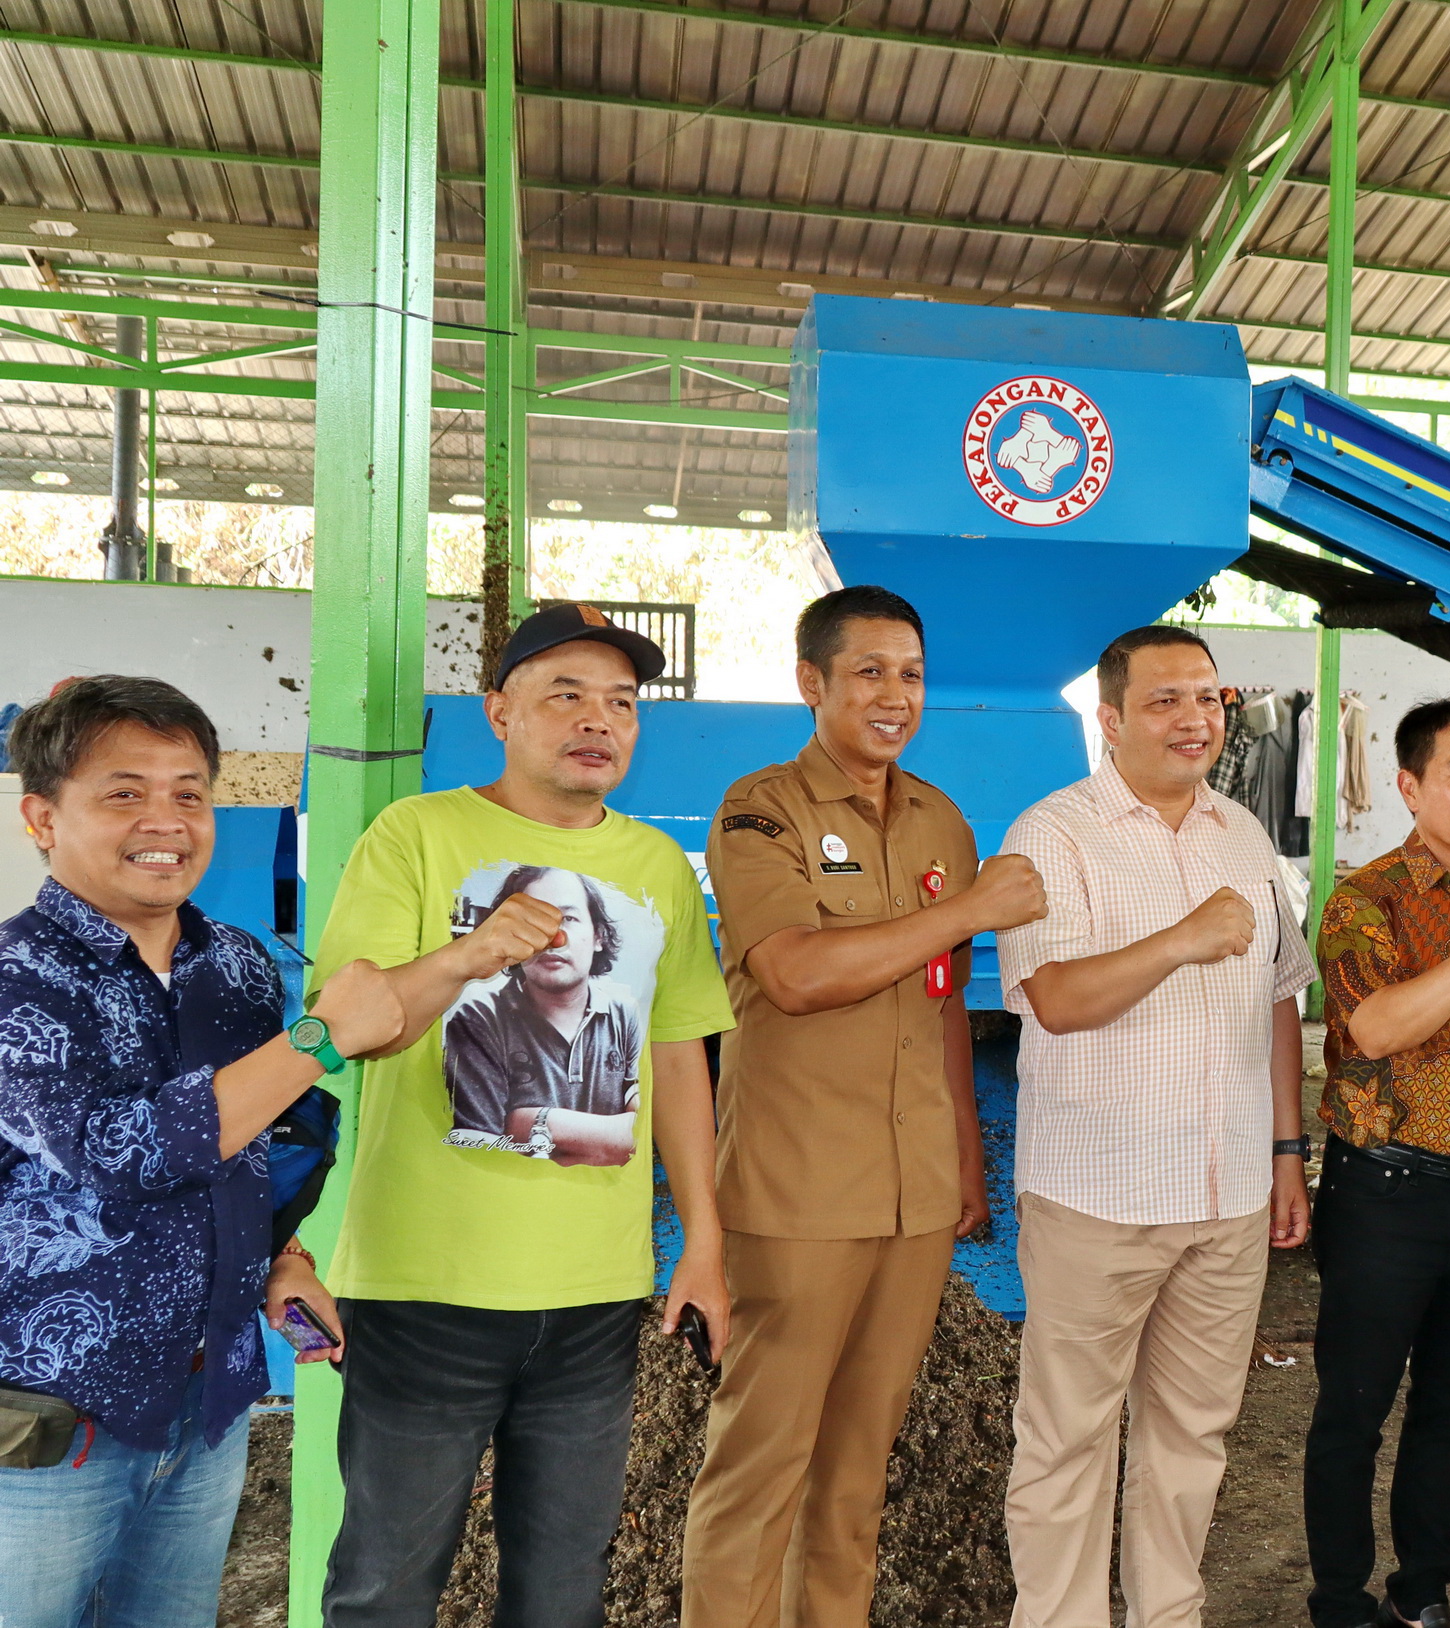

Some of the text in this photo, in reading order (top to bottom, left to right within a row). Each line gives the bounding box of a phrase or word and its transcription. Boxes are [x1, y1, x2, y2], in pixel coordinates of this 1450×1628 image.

[968, 380, 1109, 519] PEKALONGAN TANGGAP
[442, 1131, 556, 1153] Sweet Memories
